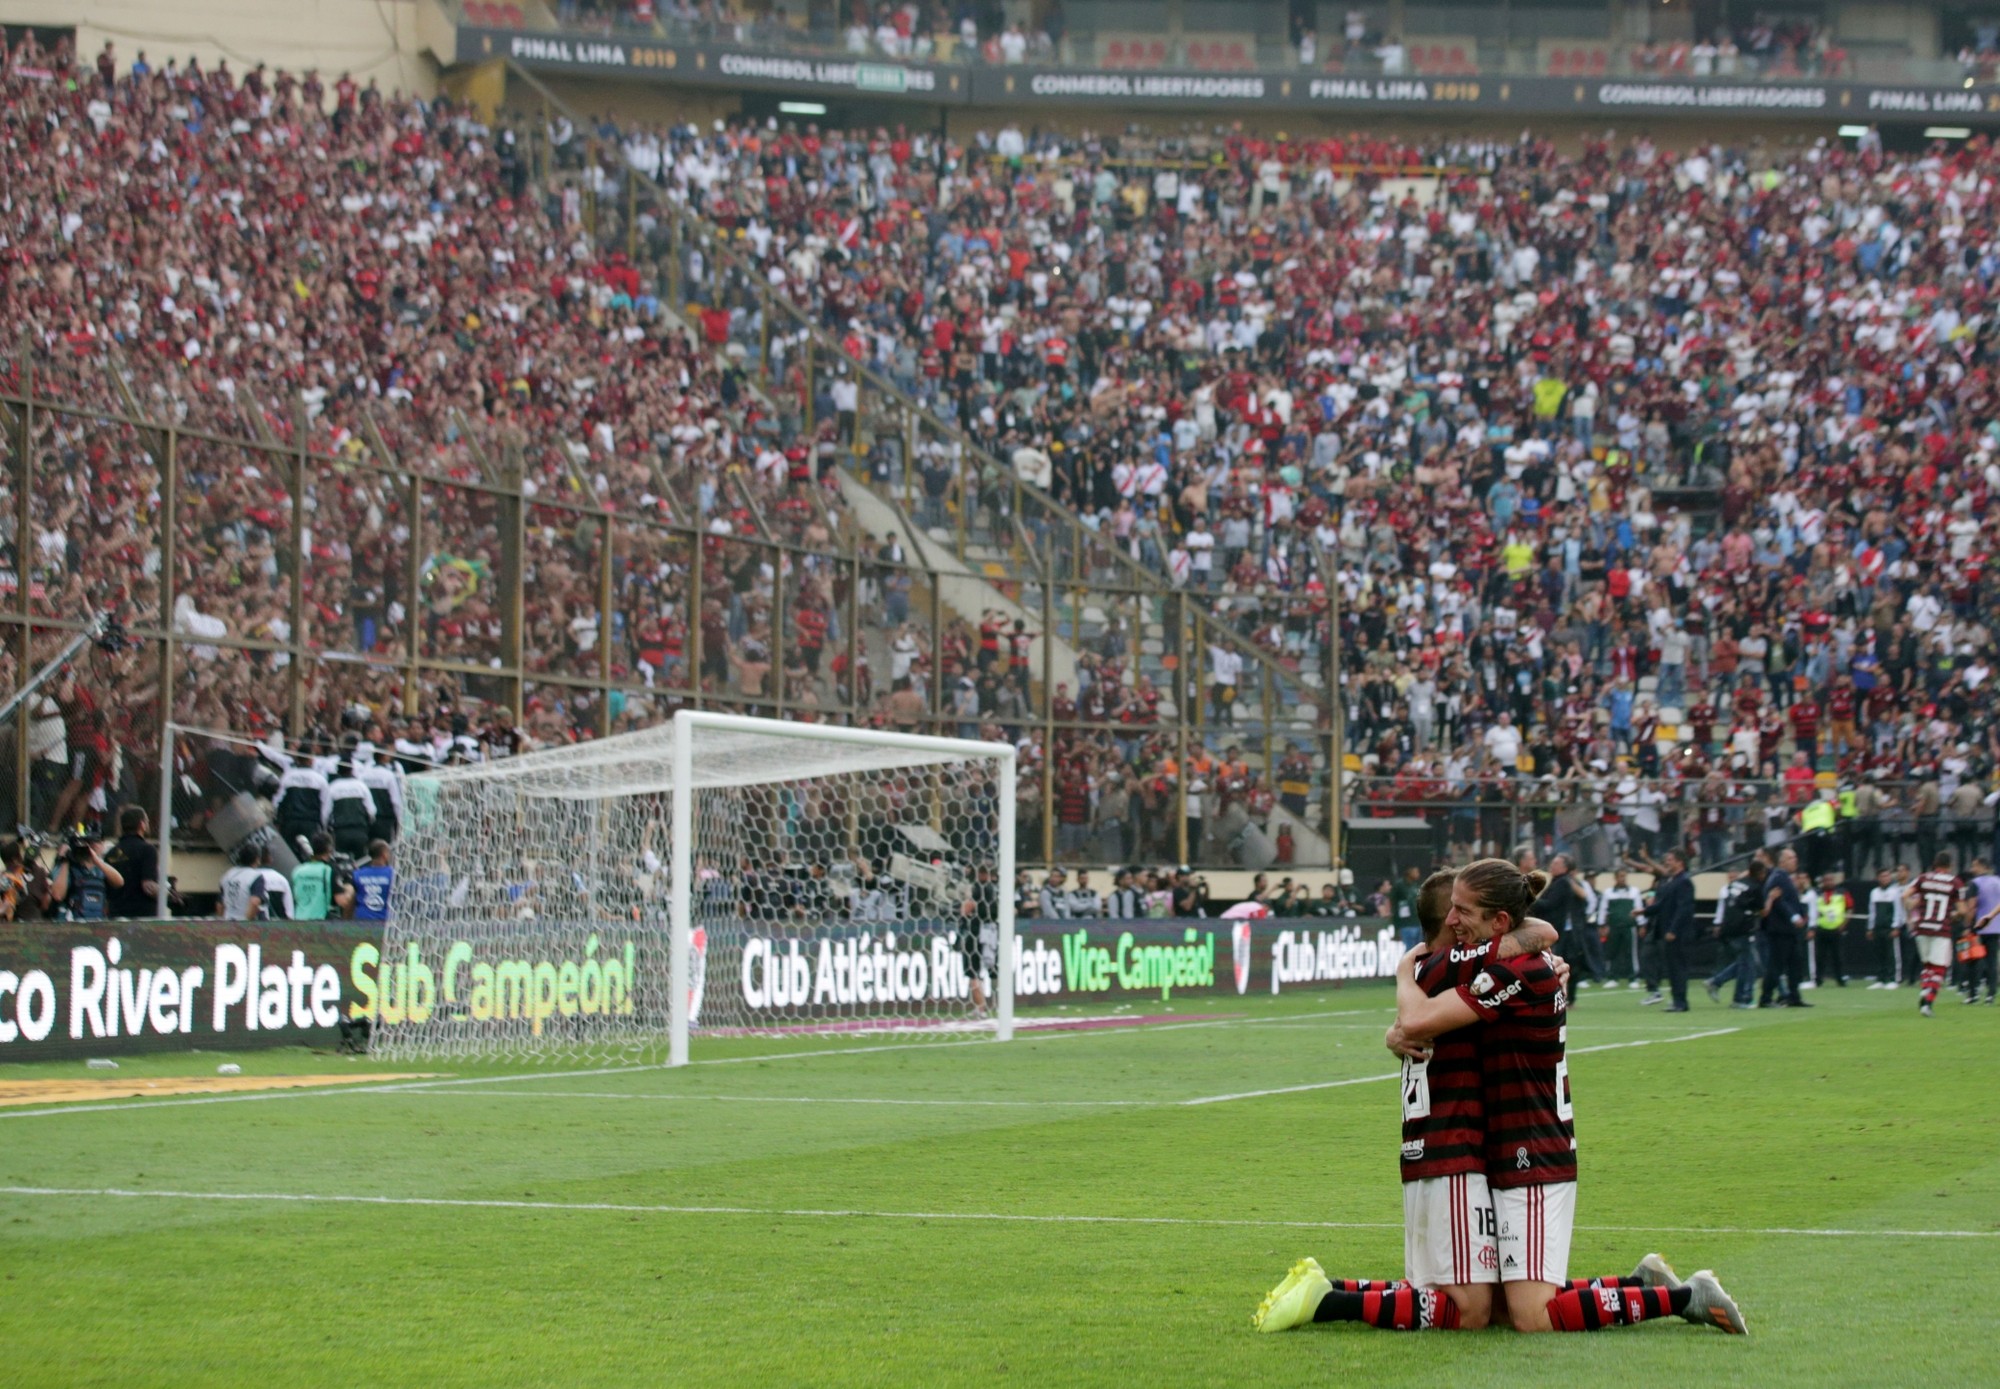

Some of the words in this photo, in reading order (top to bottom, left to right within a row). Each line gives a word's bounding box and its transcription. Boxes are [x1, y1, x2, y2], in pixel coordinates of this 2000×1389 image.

[511, 37, 572, 62] FINAL
[576, 42, 626, 66] LIMA
[631, 46, 677, 69] 2019
[719, 53, 814, 81] CONMEBOL
[1031, 74, 1132, 95] CONMEBOL
[1133, 76, 1265, 98] LIBERTADORES
[1309, 79, 1372, 99] FINAL
[1376, 81, 1428, 100] LIMA
[1433, 82, 1480, 101] 2019
[1598, 84, 1697, 105] CONMEBOL
[1698, 86, 1826, 108] LIBERTADORES
[1868, 90, 1930, 111] FINAL
[1933, 91, 1984, 112] LIMA
[1315, 925, 1378, 980] Atlético
[1449, 941, 1494, 963] buser
[741, 937, 811, 1008] Club
[813, 930, 928, 1005] Atlético
[1062, 928, 1214, 1001] Vice-Campeão!
[69, 936, 204, 1040] River
[212, 942, 341, 1032] Plate
[349, 942, 436, 1025] Sub
[443, 933, 635, 1036] Campeón!
[1477, 979, 1523, 1009] buser
[1474, 1207, 1497, 1237] 18
